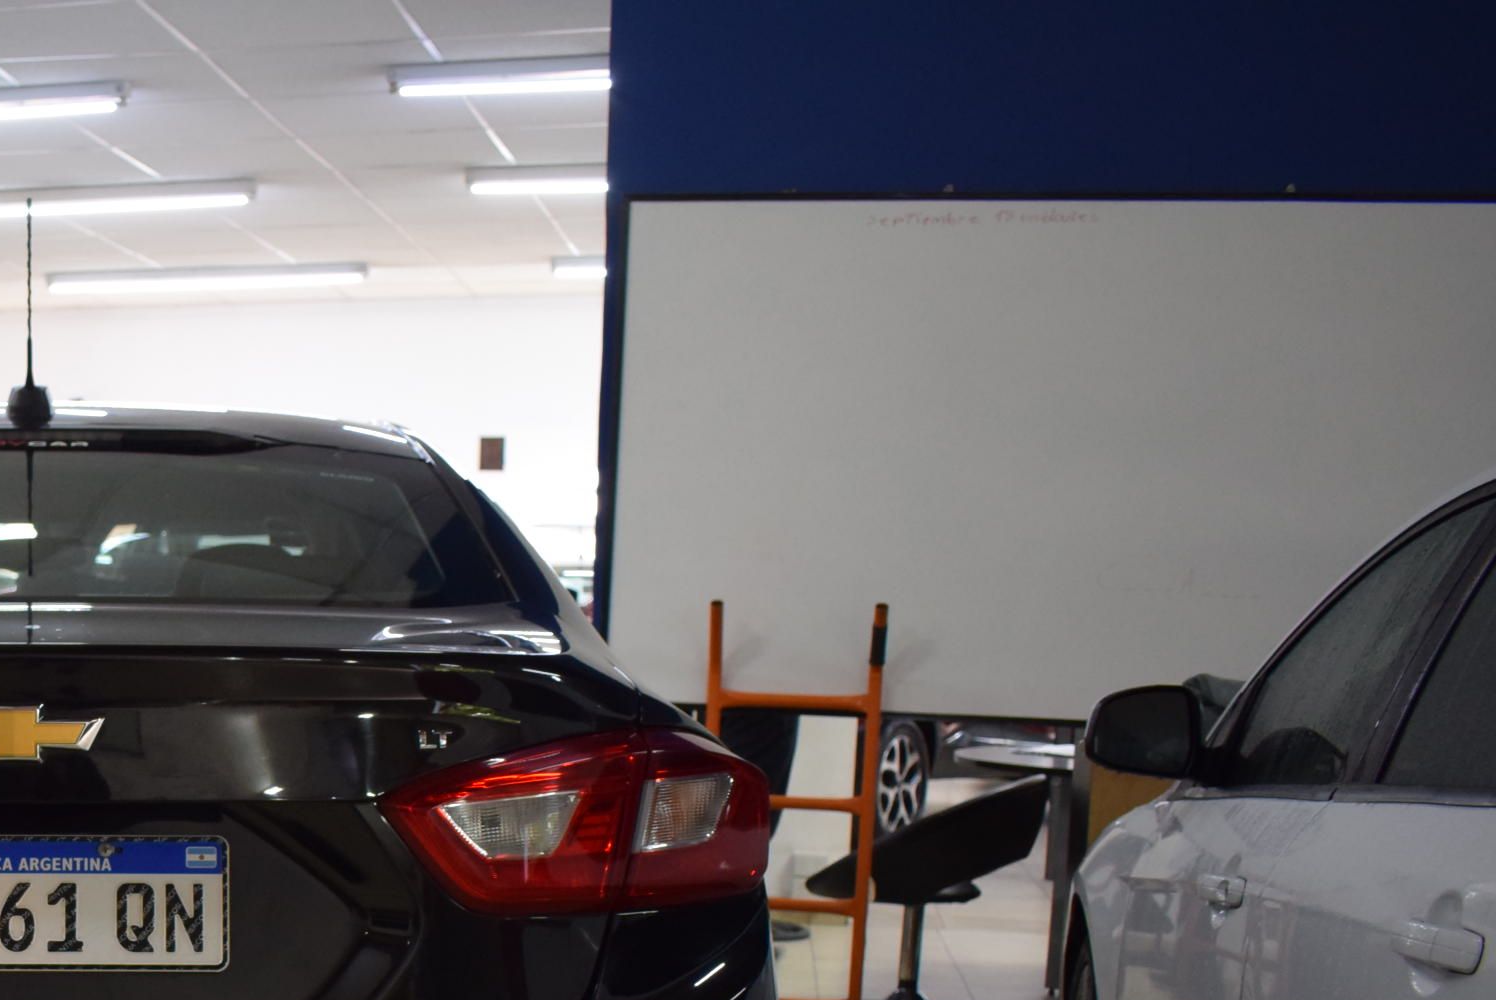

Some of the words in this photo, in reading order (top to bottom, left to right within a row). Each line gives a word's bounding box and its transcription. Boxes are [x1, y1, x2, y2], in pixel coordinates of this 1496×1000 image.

[418, 728, 453, 750] LT
[18, 856, 113, 872] ARGENTINA
[115, 882, 205, 953] QN
